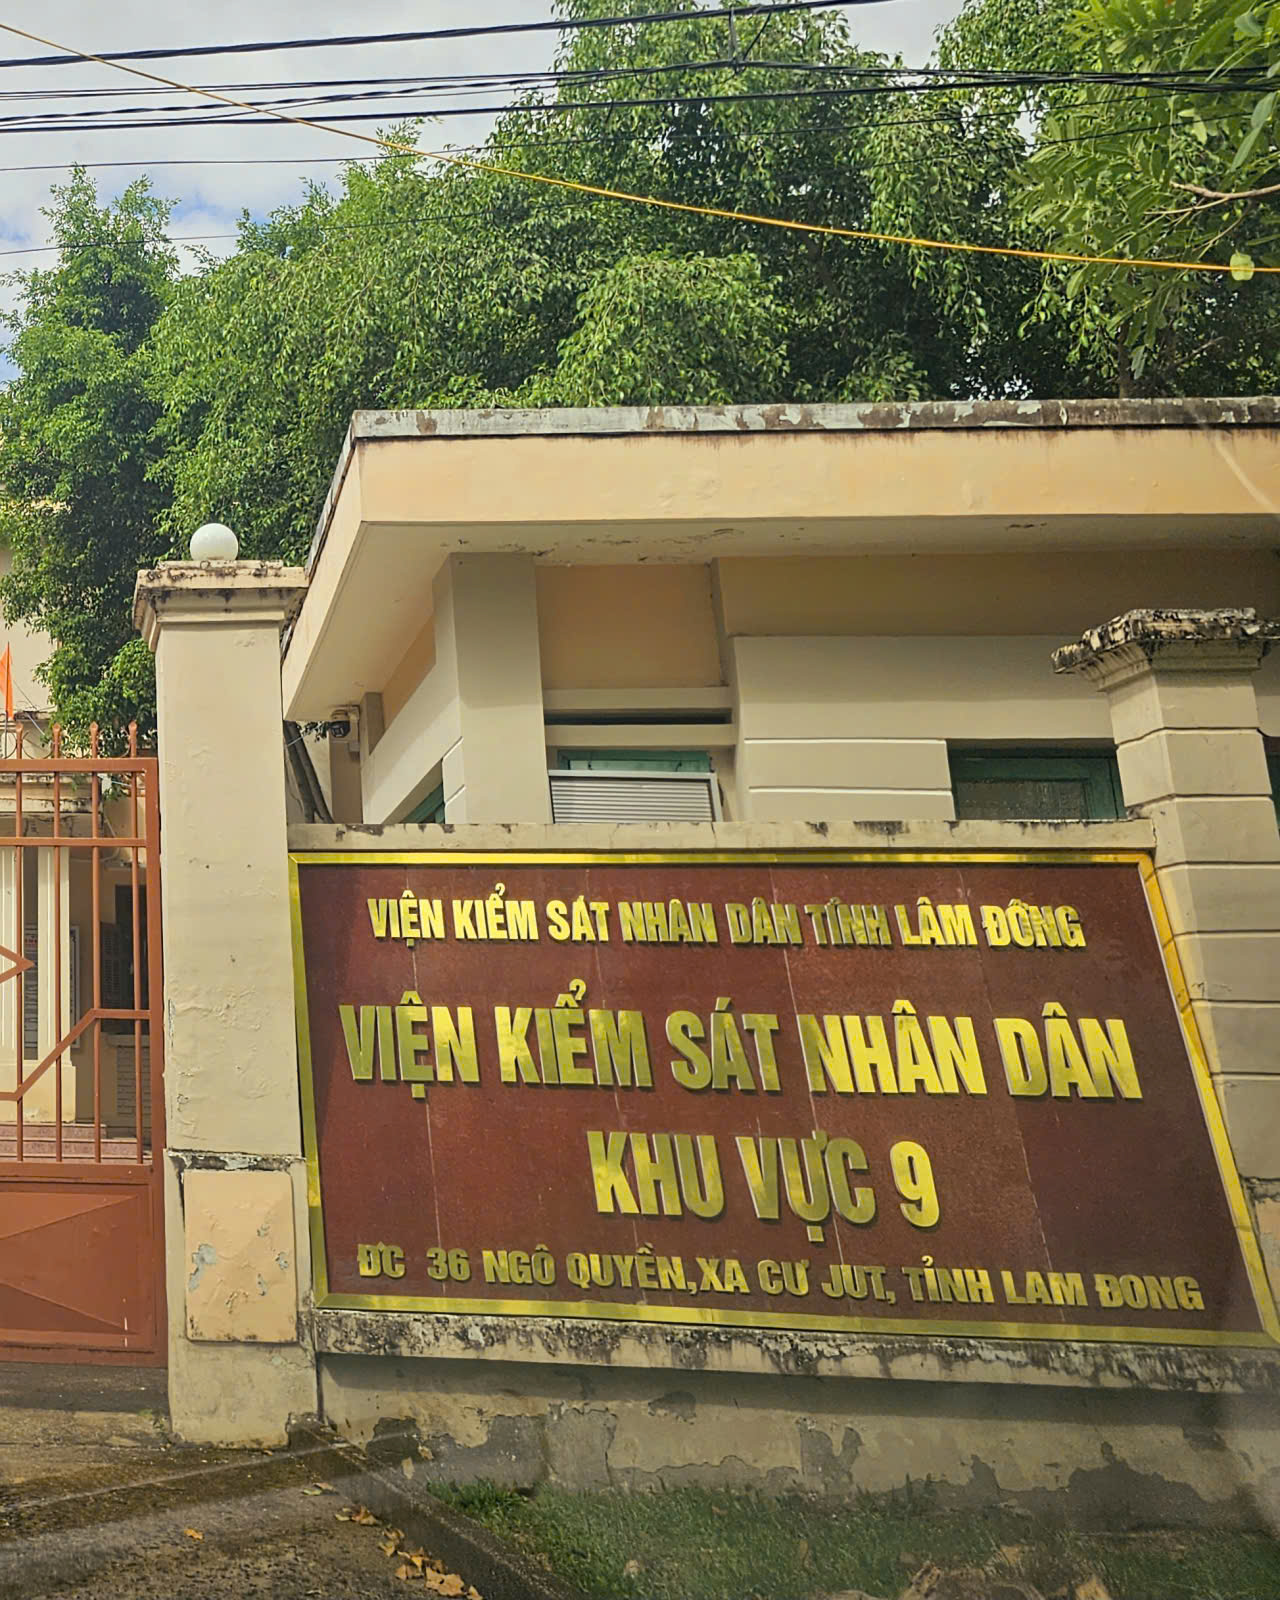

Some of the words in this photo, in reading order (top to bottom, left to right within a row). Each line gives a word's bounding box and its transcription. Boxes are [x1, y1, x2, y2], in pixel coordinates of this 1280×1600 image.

[367, 890, 446, 947] VIỆN
[452, 883, 540, 941] KIỂM
[546, 895, 610, 942] SÁT
[618, 898, 718, 943] NHÂN
[725, 897, 805, 945] DÂN
[894, 896, 979, 946] LÂM
[338, 990, 481, 1099] VIỆN
[494, 979, 654, 1088] KIỂM
[665, 997, 781, 1091] SÁT
[797, 1000, 988, 1095] NHÂN
[992, 1002, 1143, 1099] DÂN
[587, 1130, 725, 1218] KHU
[735, 1130, 877, 1242] VỰC
[889, 1140, 941, 1228] 9
[426, 1248, 471, 1281] 36
[481, 1244, 557, 1286] NGÔ
[757, 1259, 810, 1297] CƯ
[821, 1264, 897, 1305] JUT,
[901, 1255, 996, 1304] TỈNH
[1000, 1270, 1089, 1307] LAM
[1093, 1273, 1206, 1311] ĐONG
